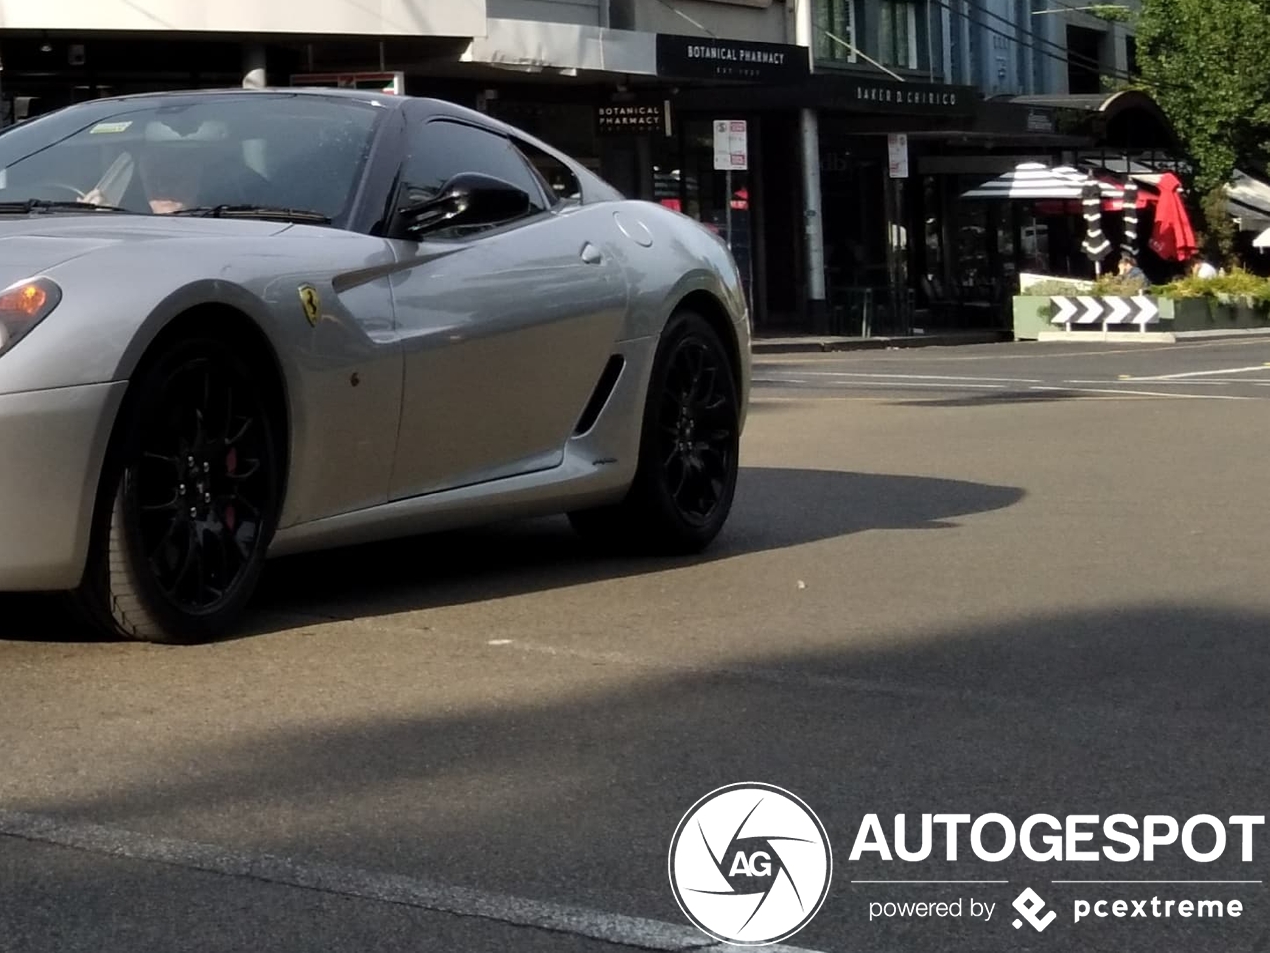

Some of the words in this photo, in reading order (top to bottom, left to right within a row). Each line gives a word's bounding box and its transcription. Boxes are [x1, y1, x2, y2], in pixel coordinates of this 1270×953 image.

[687, 45, 737, 61] BOTANICAL
[739, 49, 785, 65] PHARMACY
[857, 86, 891, 102] BAKER
[907, 91, 956, 106] CHIRICO
[598, 107, 660, 116] BOTANICAL
[599, 116, 659, 125] PHARMACY
